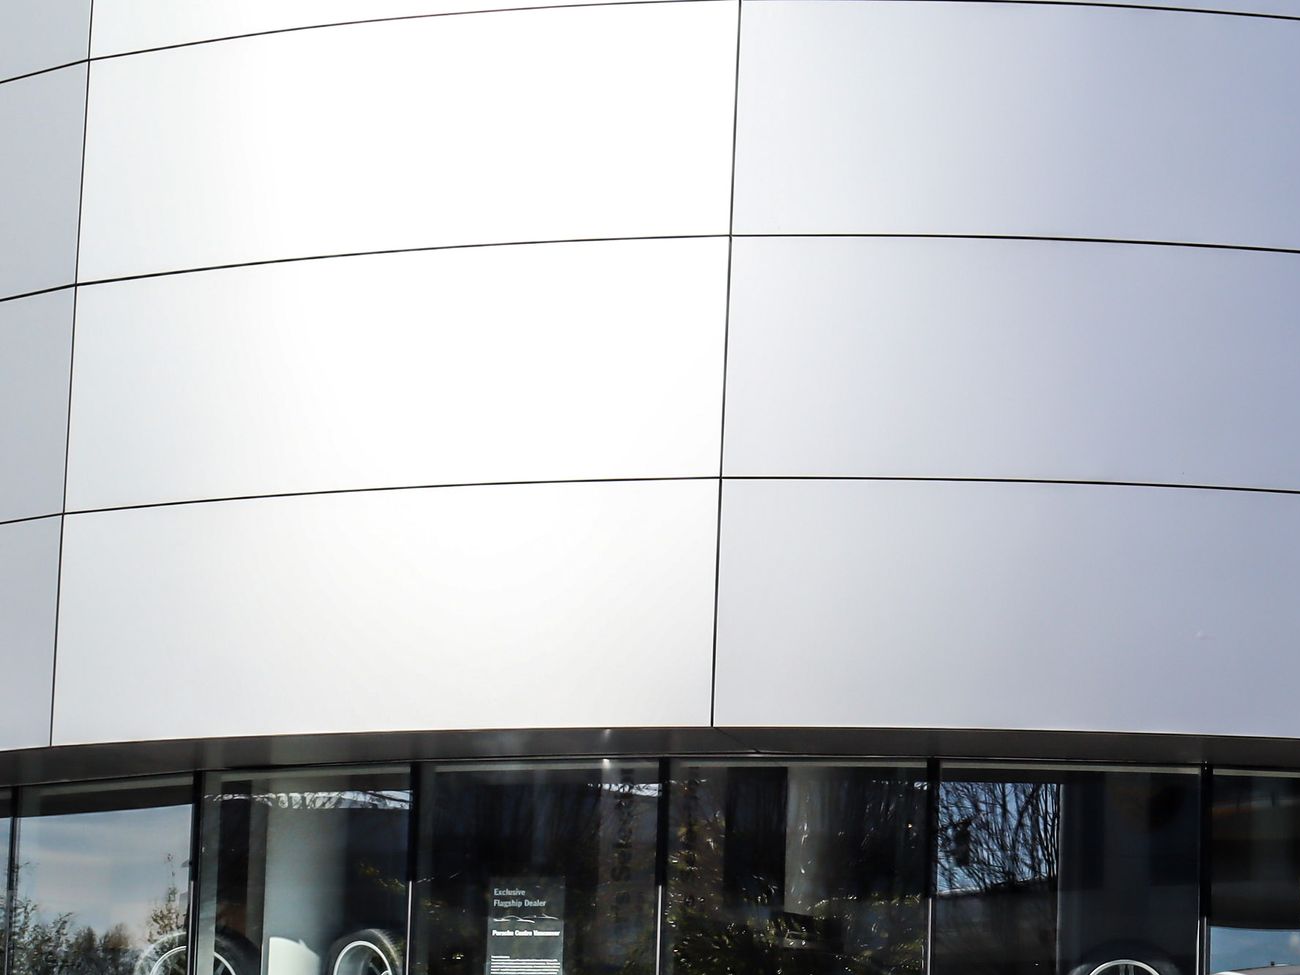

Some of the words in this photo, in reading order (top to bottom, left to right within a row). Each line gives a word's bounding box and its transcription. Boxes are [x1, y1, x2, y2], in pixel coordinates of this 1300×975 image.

[493, 888, 526, 896] Exclusive
[493, 899, 523, 908] Flagship
[524, 899, 546, 907] Dealer
